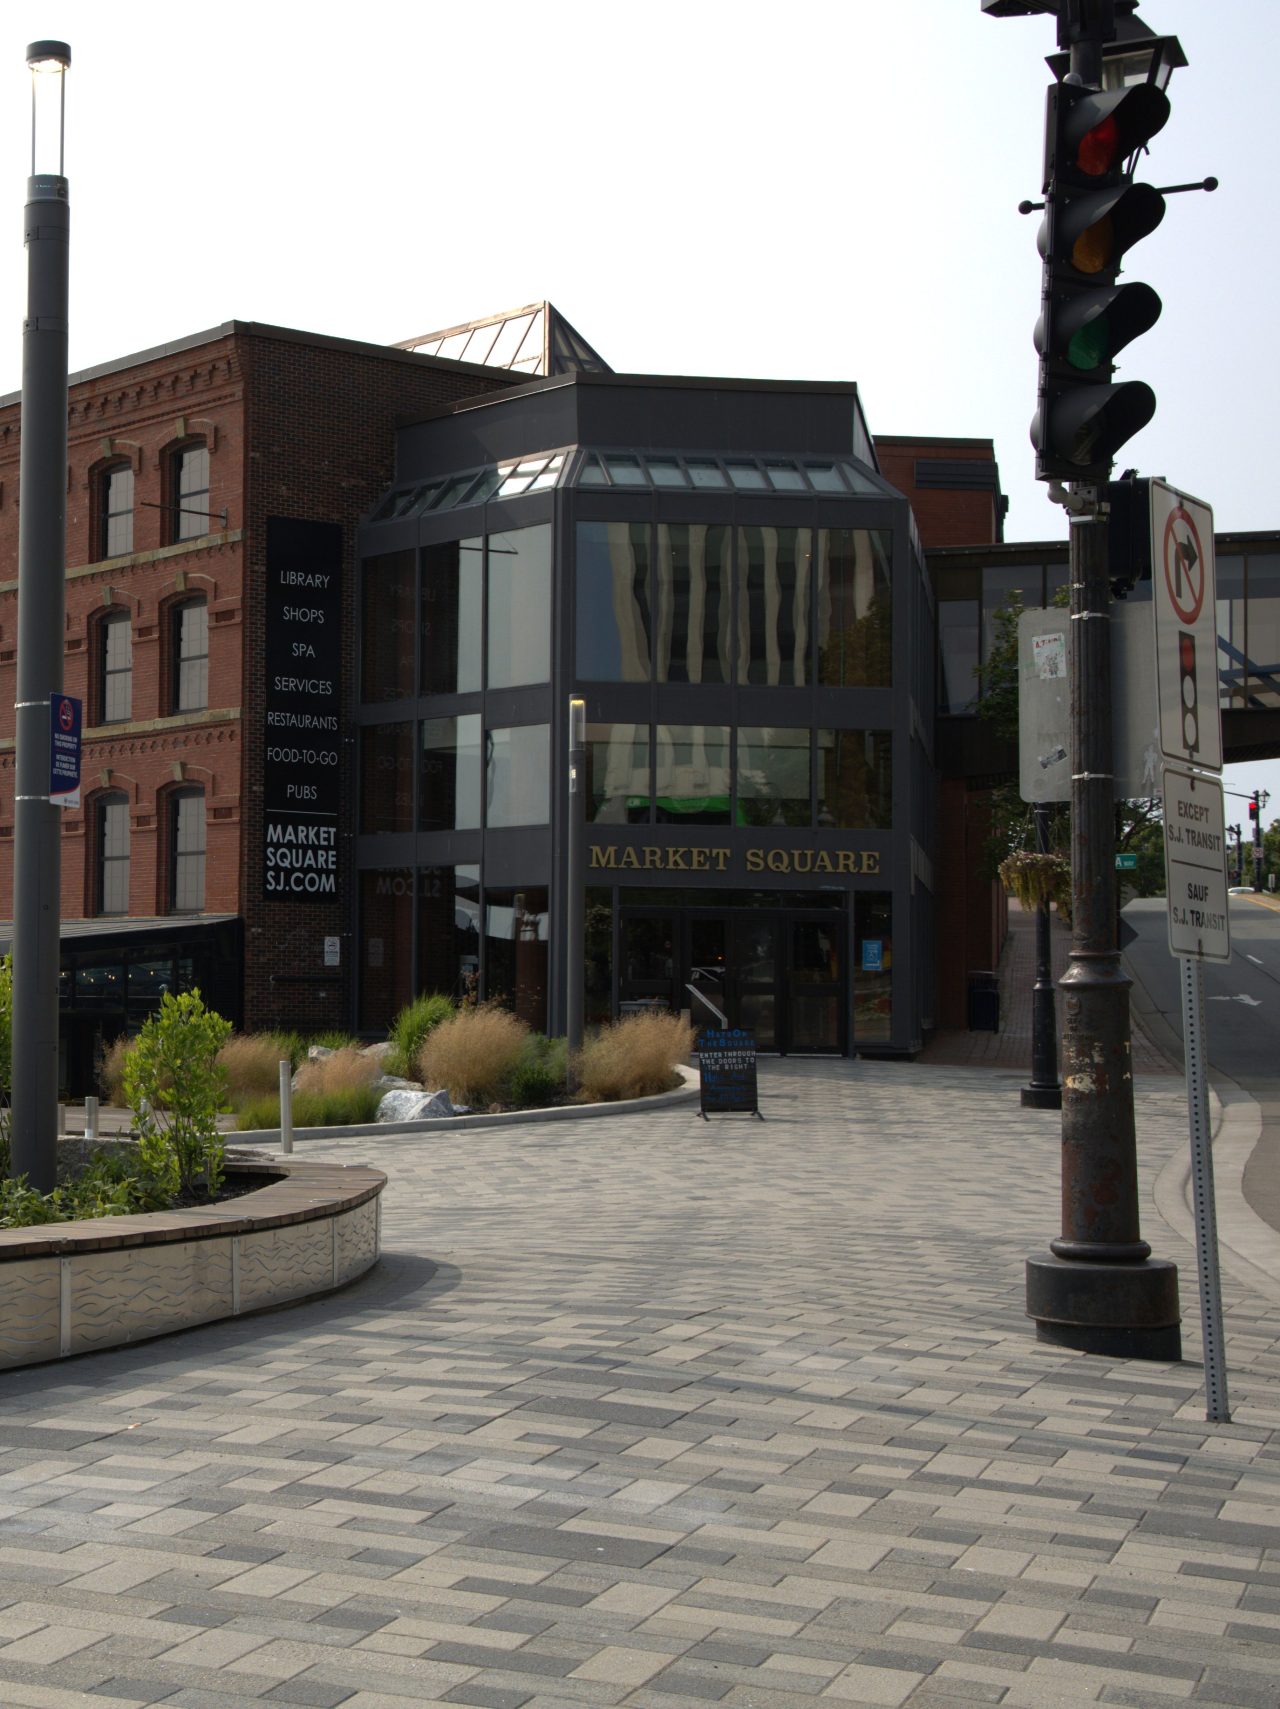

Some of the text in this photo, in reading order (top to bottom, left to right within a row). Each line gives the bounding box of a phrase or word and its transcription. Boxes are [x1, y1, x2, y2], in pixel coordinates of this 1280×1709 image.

[280, 570, 330, 588] LIBRARY
[282, 606, 325, 624] SHOPS
[291, 643, 317, 658] SPA
[274, 676, 332, 695] SERVICES
[267, 711, 338, 730] RESTAURANTS
[267, 747, 338, 766] FOOD-TO-GO
[287, 784, 317, 800] PUBS
[1177, 799, 1209, 824] EXCEPT
[266, 824, 336, 846] MARKET
[1168, 824, 1220, 852] S.J. TRANSIT
[266, 847, 336, 869] SQUARE
[589, 845, 880, 874] MARKET SQUARE
[266, 870, 336, 893] SJ.COM
[1187, 882, 1208, 902] SAUF
[1173, 906, 1225, 932] S.J. TRANSIT
